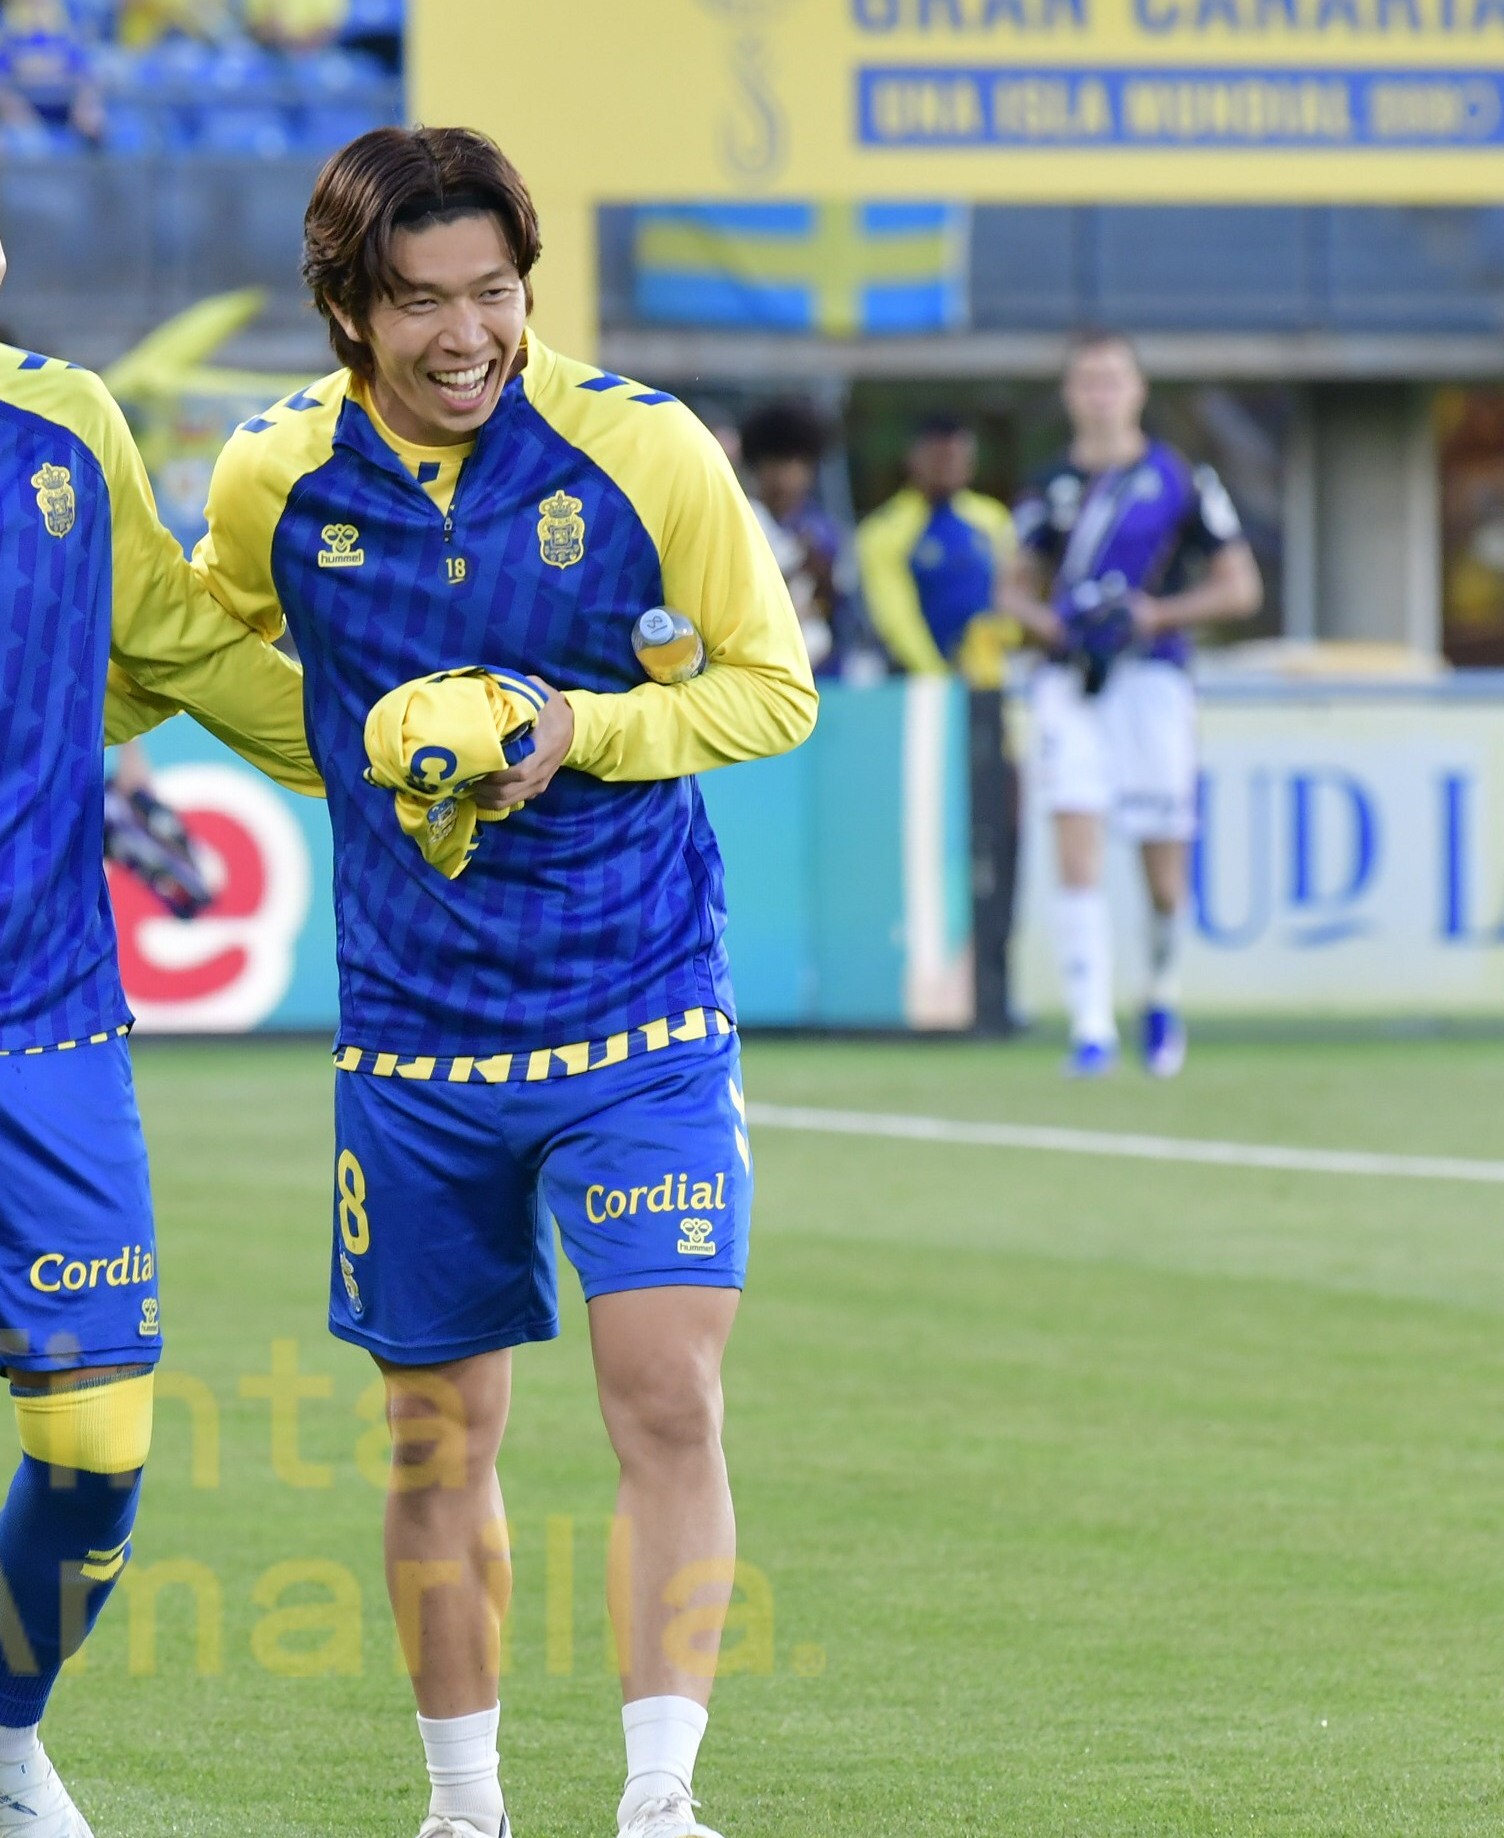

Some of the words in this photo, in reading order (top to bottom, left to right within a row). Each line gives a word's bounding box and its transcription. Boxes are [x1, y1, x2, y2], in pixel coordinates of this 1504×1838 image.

[320, 552, 362, 564] hummel
[445, 557, 467, 578] 18
[585, 1172, 726, 1224] Cordial
[679, 1242, 714, 1252] hummel
[29, 1244, 154, 1292] Cordia
